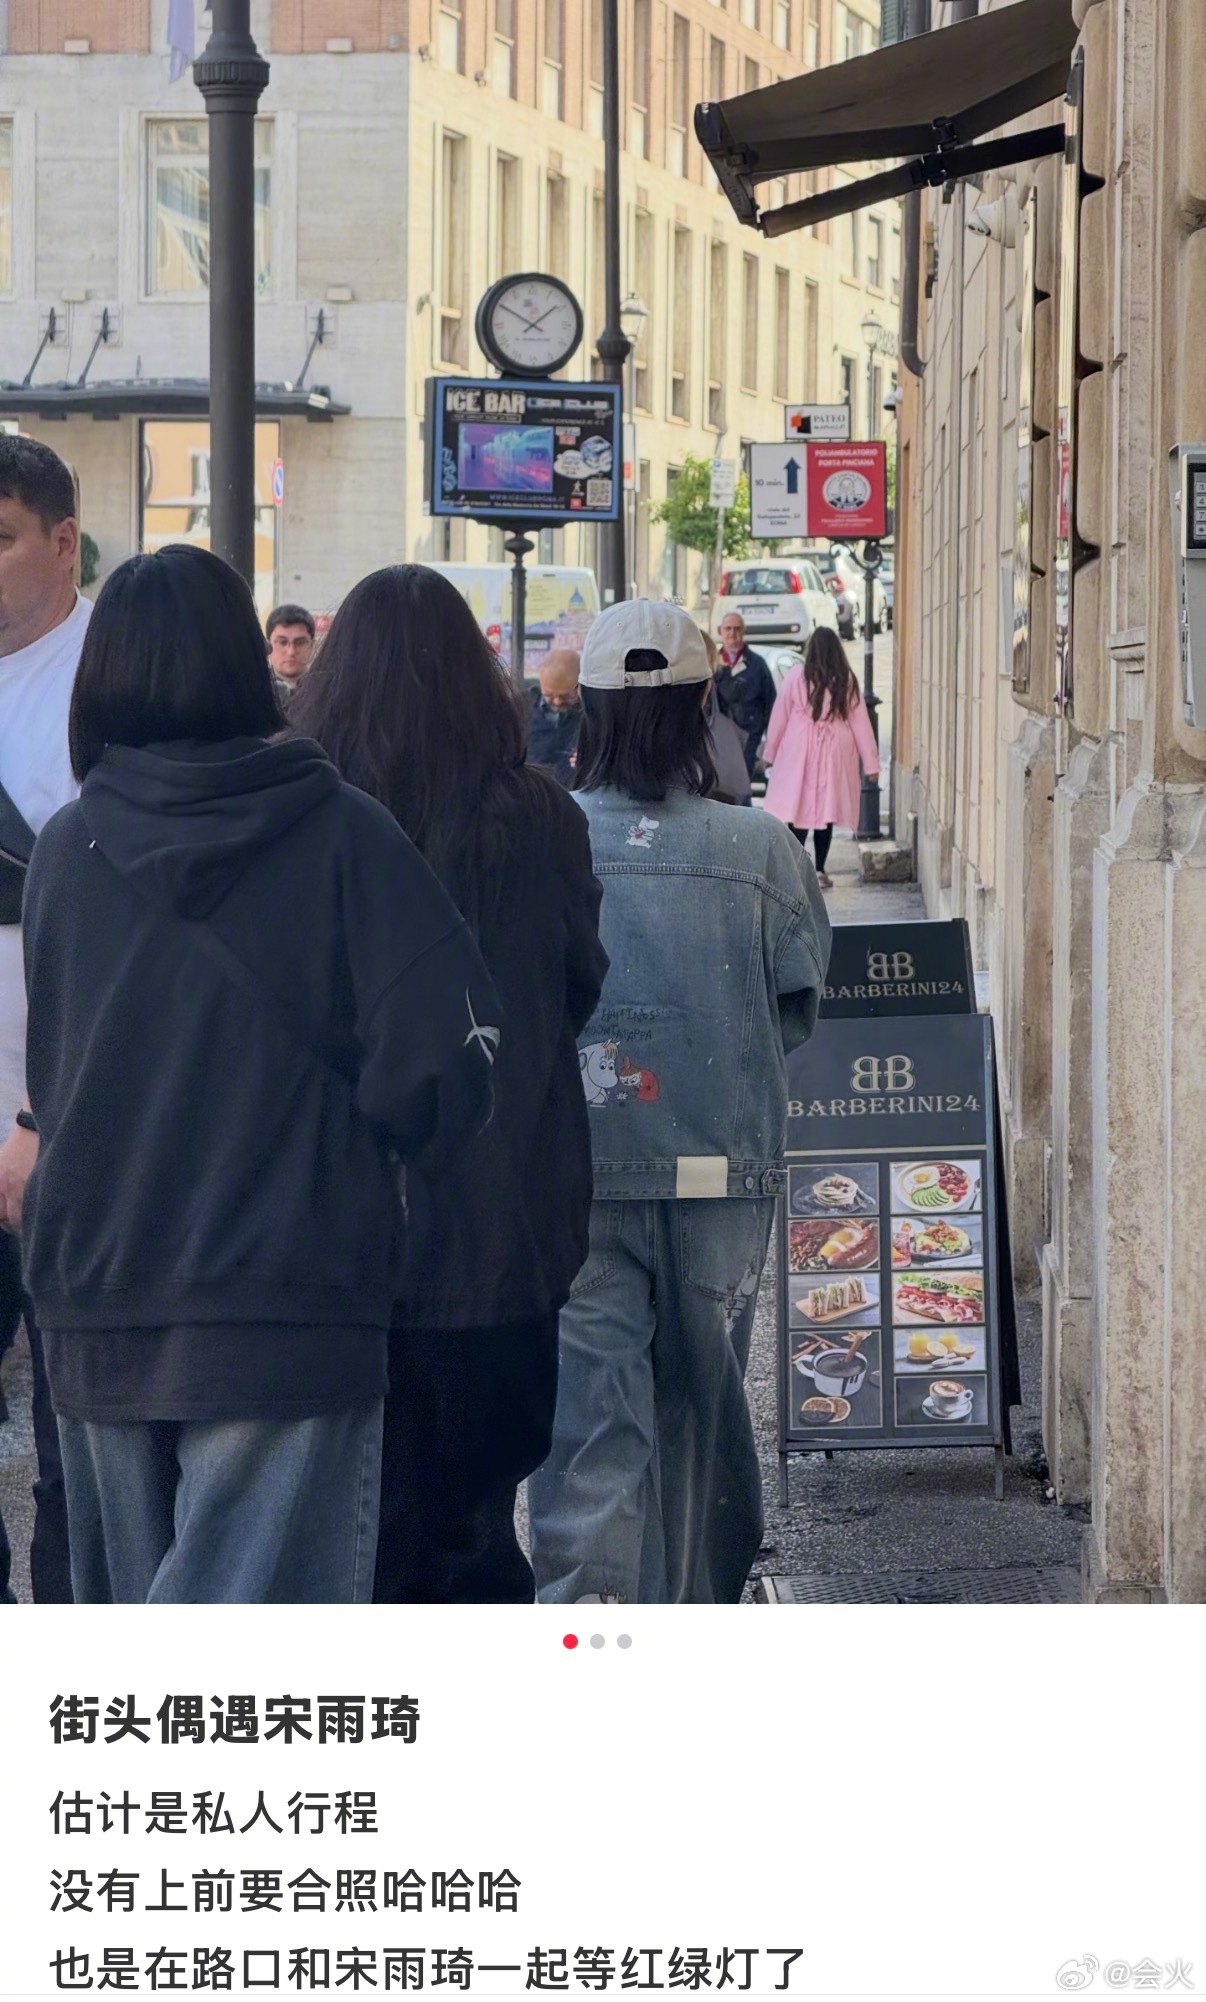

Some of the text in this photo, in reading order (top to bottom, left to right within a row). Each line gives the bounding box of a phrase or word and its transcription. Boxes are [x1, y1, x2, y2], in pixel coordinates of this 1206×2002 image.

[446, 387, 526, 414] ICE BAR
[814, 415, 846, 423] PATEO
[815, 448, 879, 457] POLIAMBULATORIO
[1199, 511, 1205, 519] 7
[822, 981, 965, 999] BARBERINI24
[786, 1094, 981, 1117] BARBERINI24
